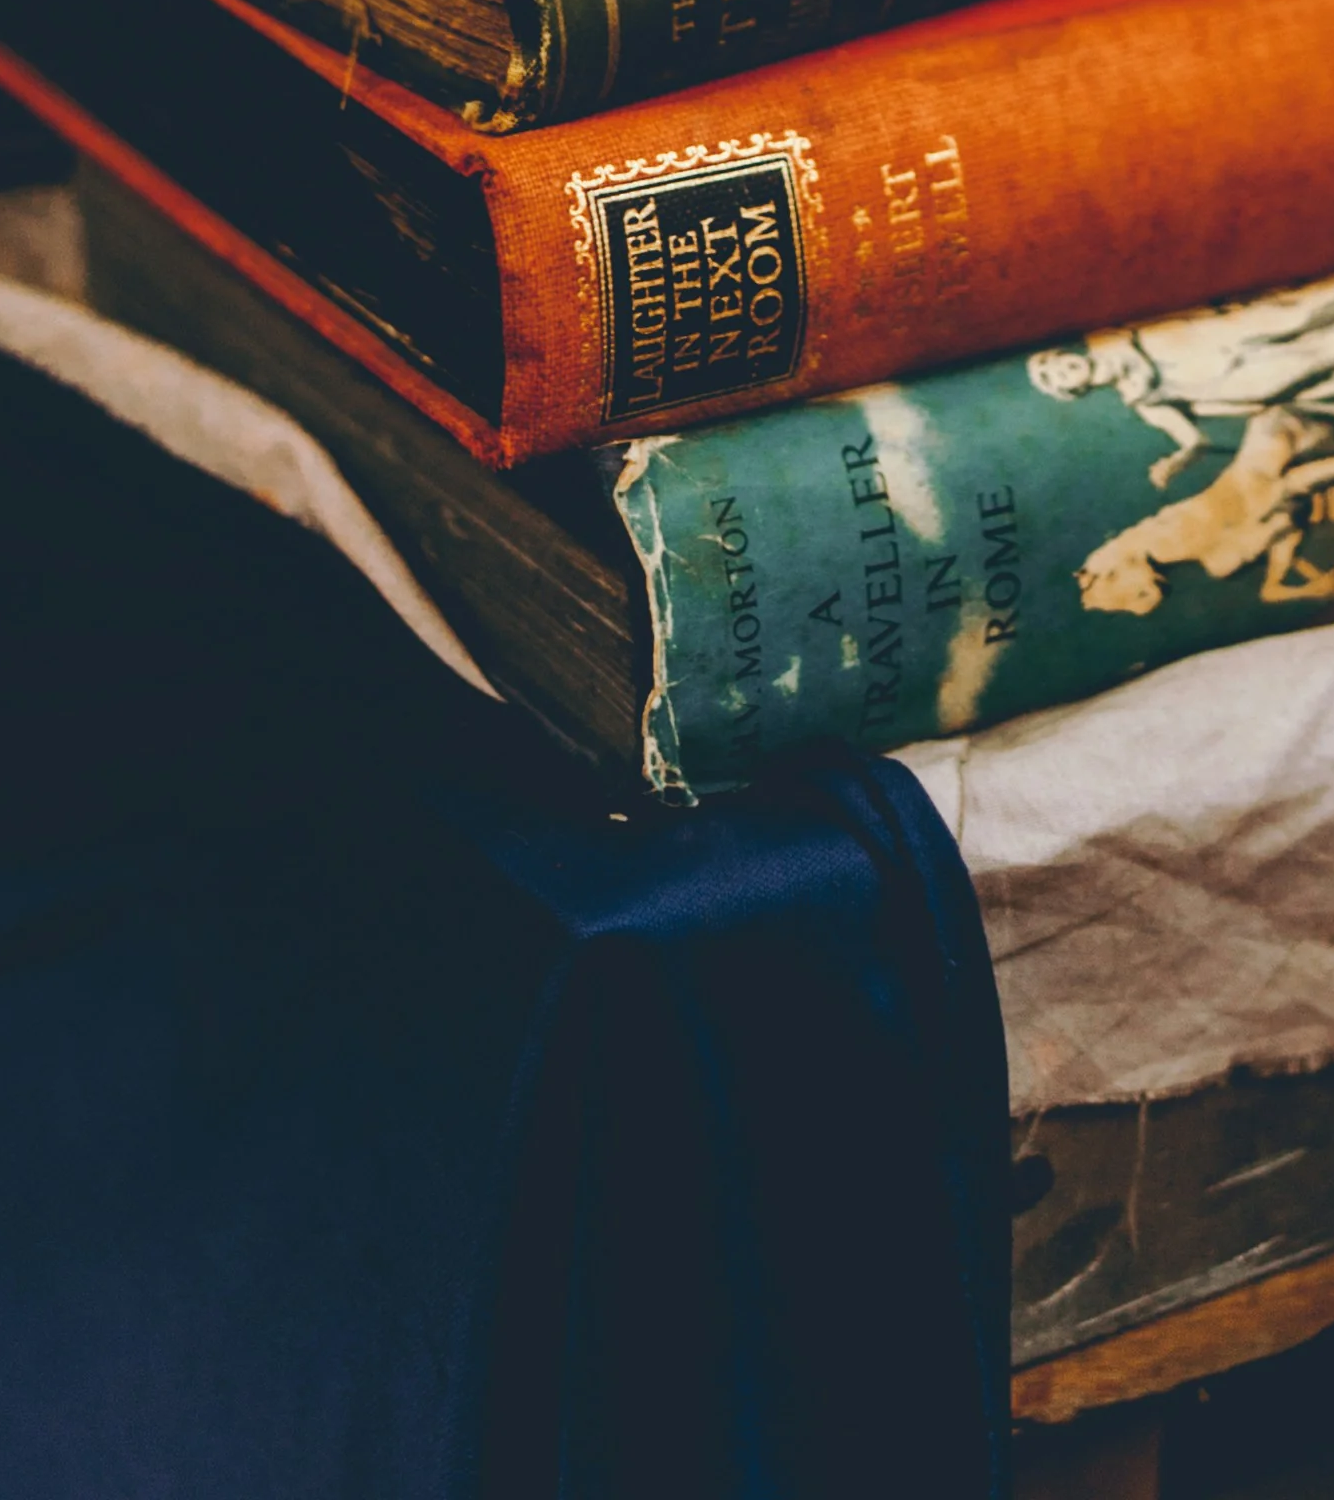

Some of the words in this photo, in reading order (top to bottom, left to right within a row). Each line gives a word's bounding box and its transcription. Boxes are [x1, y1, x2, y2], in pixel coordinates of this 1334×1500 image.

[623, 197, 675, 403] LAUGHTER
[669, 228, 701, 316] THE
[701, 216, 742, 361] NEXT
[741, 201, 785, 359] ROOM
[674, 332, 701, 372] IN
[710, 495, 763, 680] MORTON
[808, 590, 843, 627] A
[840, 433, 903, 738] TRAVELLER
[923, 553, 962, 614] IN
[977, 485, 1021, 647] ROME
